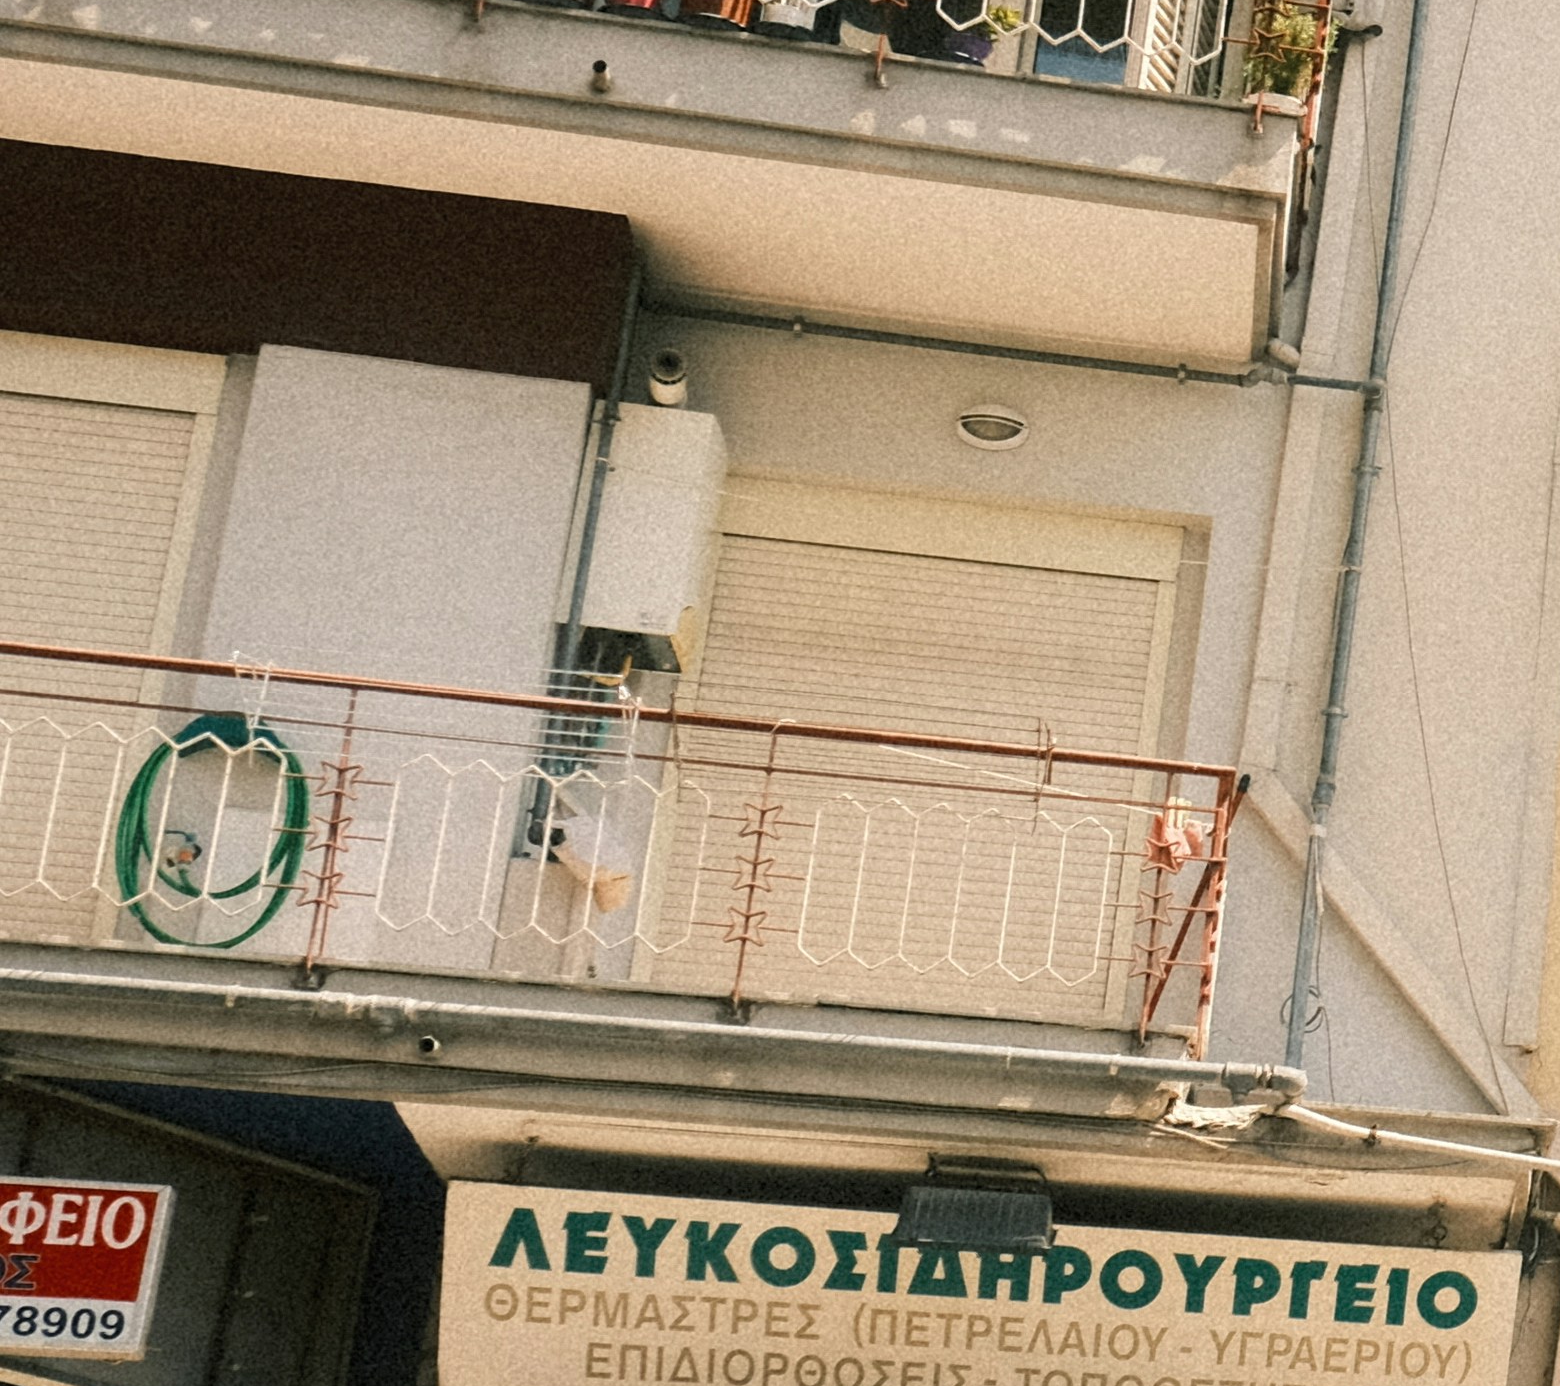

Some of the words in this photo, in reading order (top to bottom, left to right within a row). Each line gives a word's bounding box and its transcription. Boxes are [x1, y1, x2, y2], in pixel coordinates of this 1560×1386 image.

[0, 1191, 146, 1250] ΦΕΙΟ
[0, 1252, 41, 1290] Σ
[488, 1207, 1478, 1330] ΛΕΥΚΟΣΙΔΗΡΟΥΡΓΕΙΟ
[484, 1283, 821, 1340] ΘΕΡΜΑΣΤΡΕΣ
[853, 1302, 1168, 1364] (ΠΕΤΡΕΛΑΙΟΥ
[1210, 1328, 1472, 1384] ΥΓΡΑΕΡΙΟΥ)
